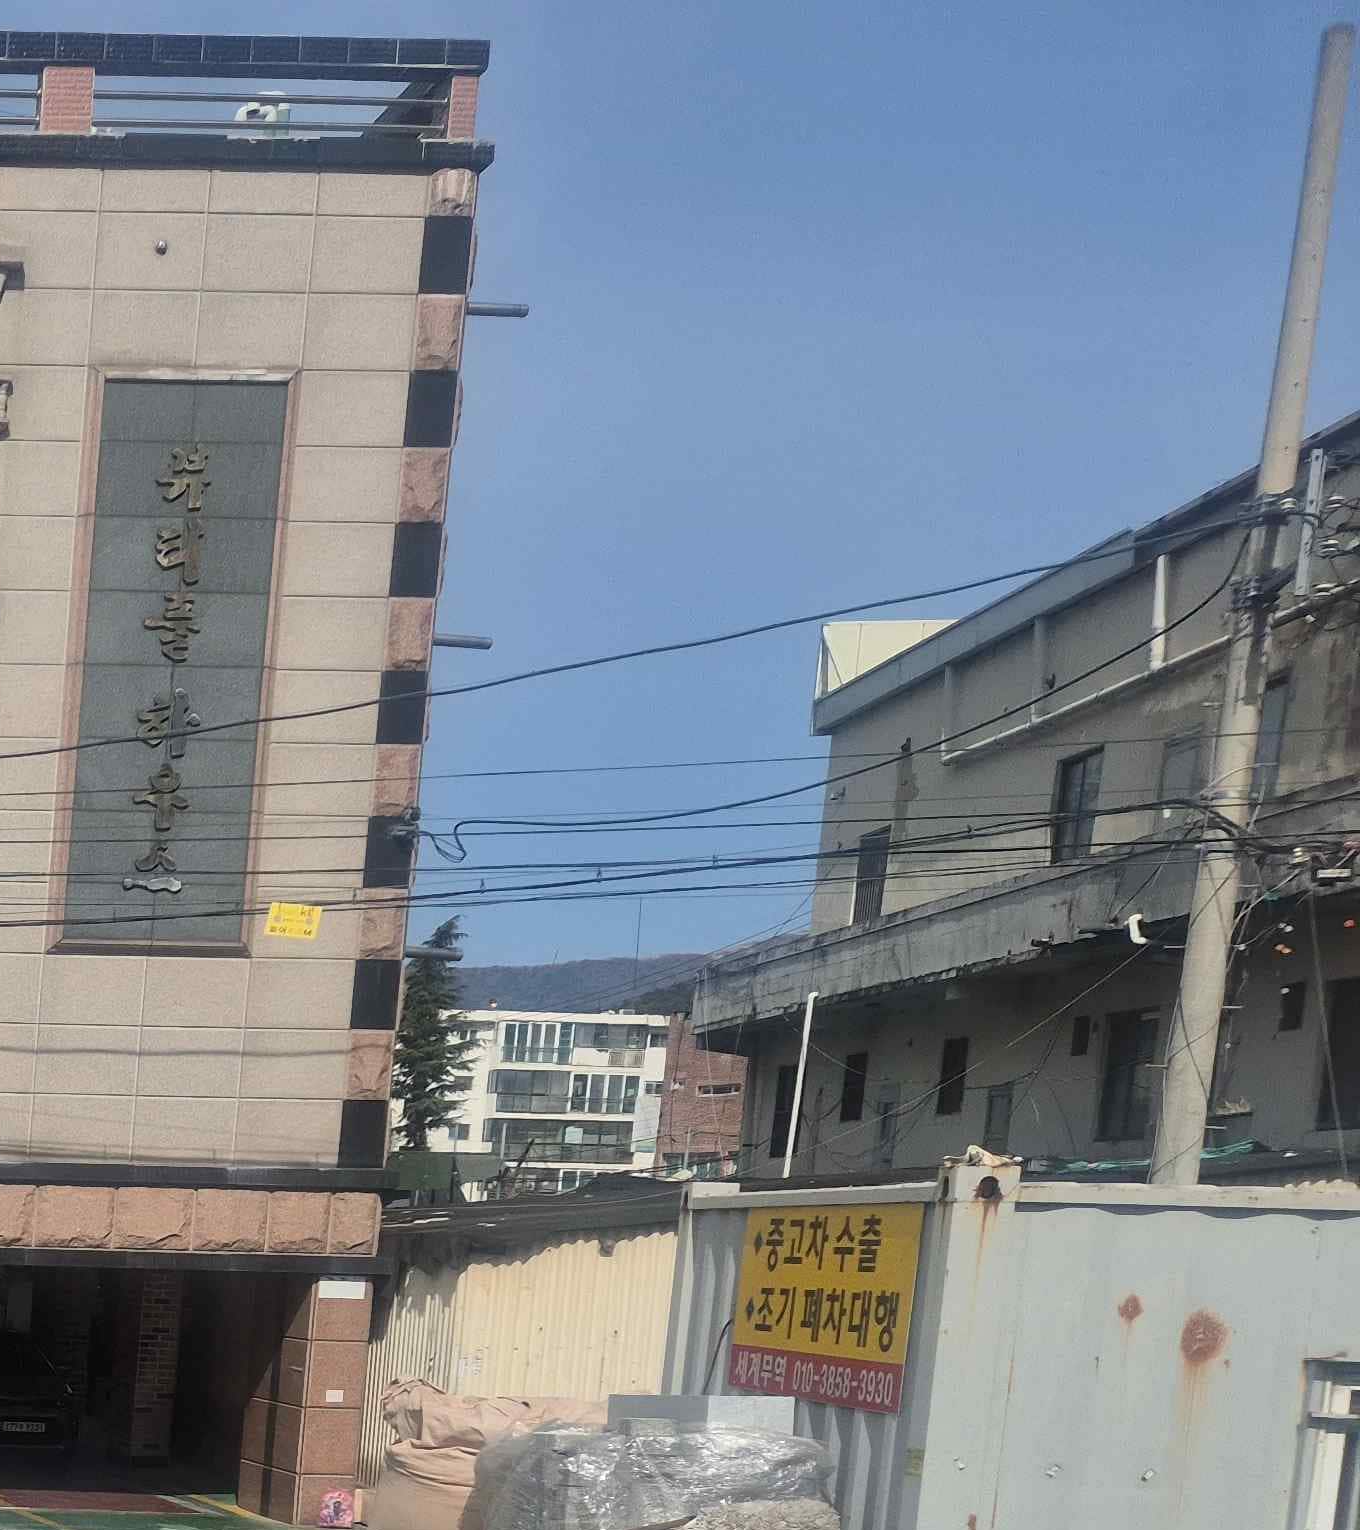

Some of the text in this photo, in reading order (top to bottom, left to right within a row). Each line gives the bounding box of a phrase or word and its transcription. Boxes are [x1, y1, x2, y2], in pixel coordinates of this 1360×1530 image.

[765, 1214, 882, 1273] 중고차 수출
[754, 1286, 900, 1352] 조기 폐차대행
[735, 1351, 894, 1406] 세계무역 010-3858-3930
